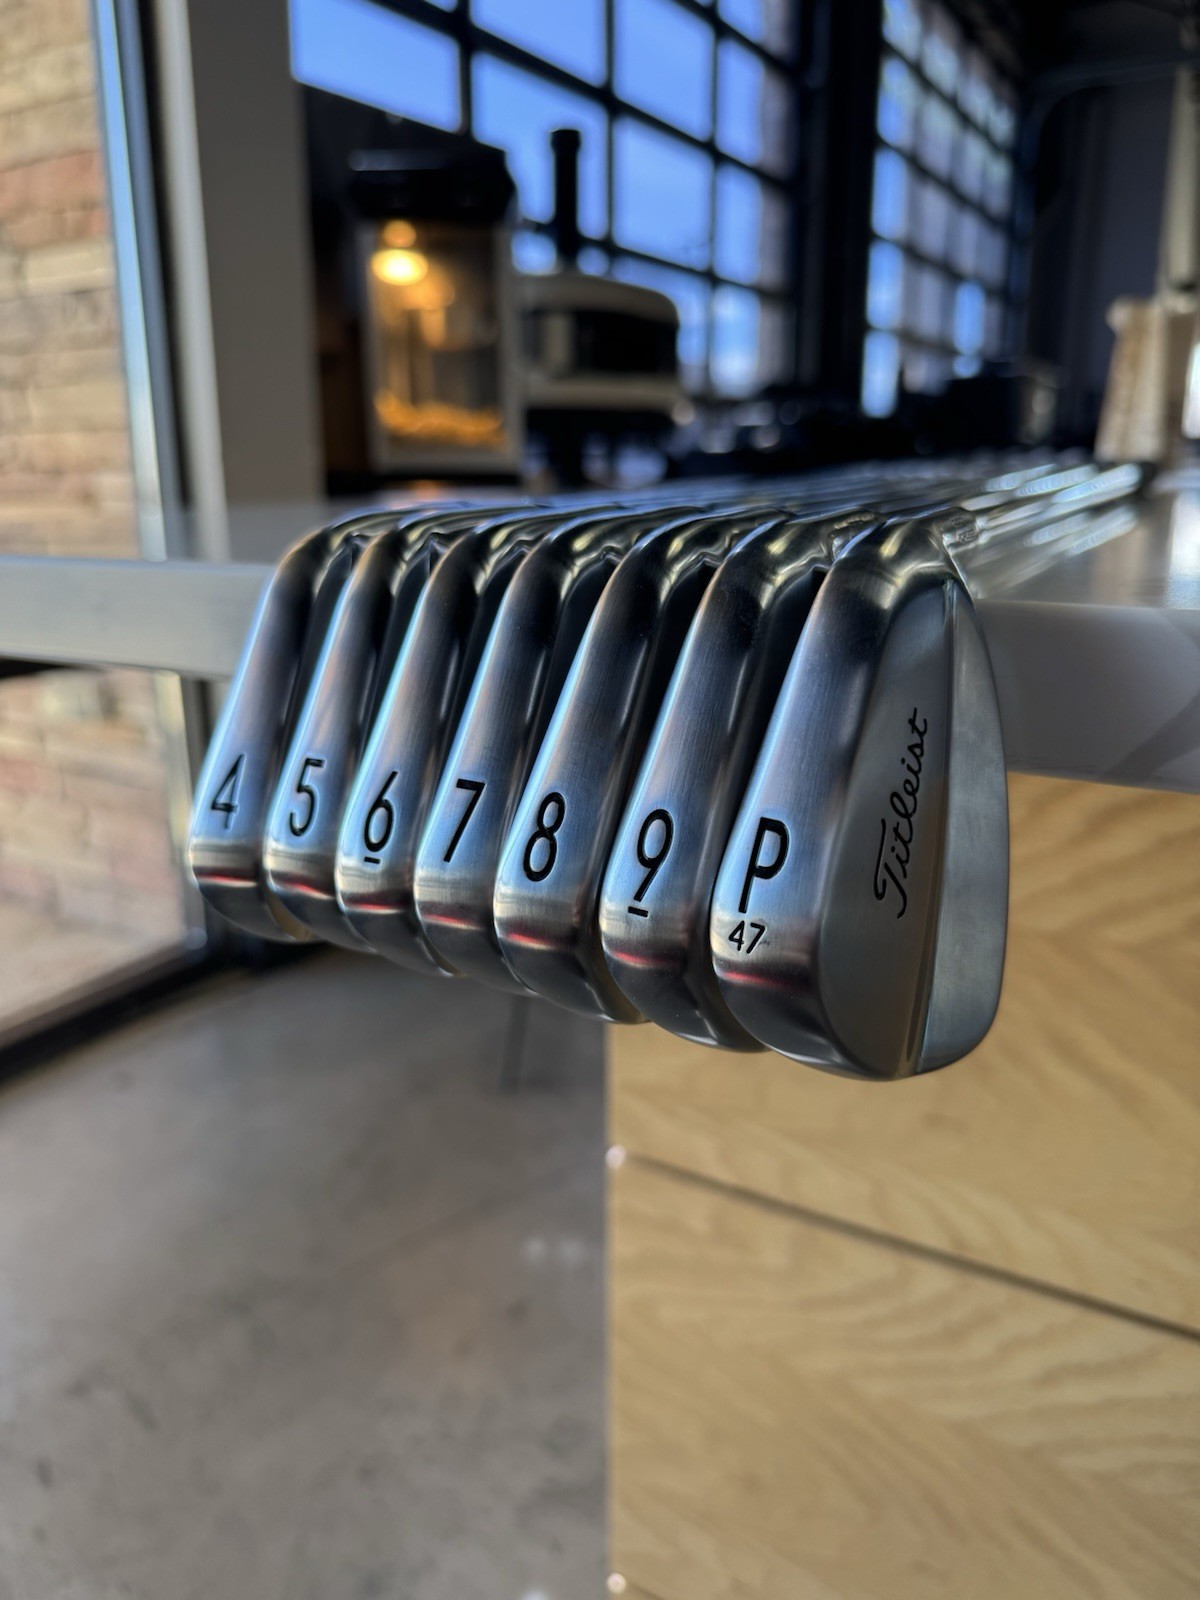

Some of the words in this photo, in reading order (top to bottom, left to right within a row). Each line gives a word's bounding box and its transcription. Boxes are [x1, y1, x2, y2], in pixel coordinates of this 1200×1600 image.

[211, 753, 246, 830] 4
[289, 757, 325, 837] 5
[364, 771, 399, 853] 6
[444, 778, 487, 863] 7
[873, 707, 928, 919] Titleist
[522, 791, 567, 883] 8
[632, 808, 675, 902] 9
[738, 816, 791, 914] P
[728, 920, 766, 954] 47
